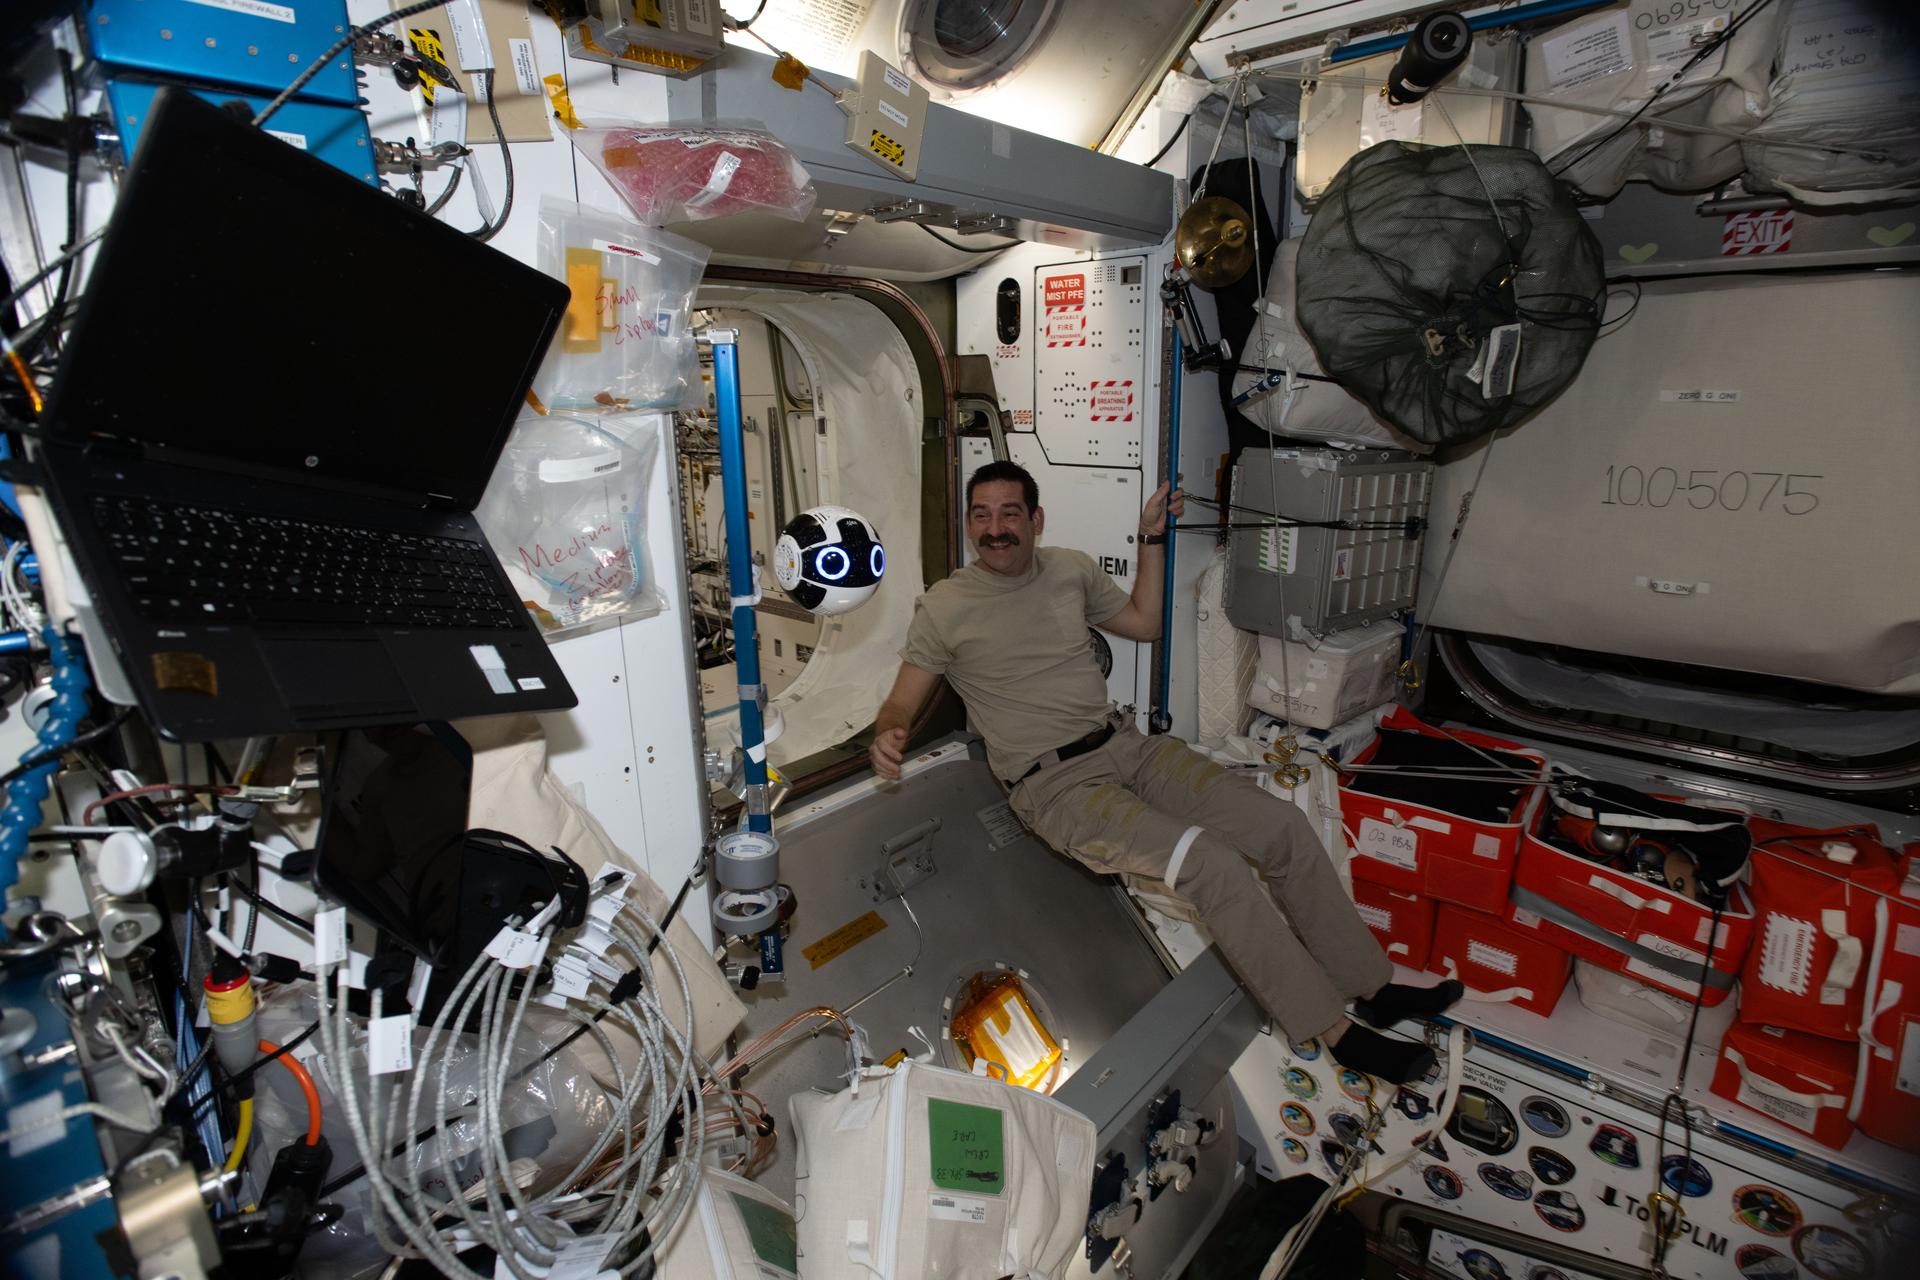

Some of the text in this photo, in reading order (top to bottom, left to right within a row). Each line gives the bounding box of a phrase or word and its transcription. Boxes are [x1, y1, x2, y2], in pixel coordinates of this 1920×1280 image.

[1734, 220, 1783, 244] EXIT
[1049, 278, 1081, 288] WATER
[1046, 290, 1084, 301] MIST PFE
[518, 523, 611, 577] Medium
[1463, 1065, 1486, 1078] DECK
[1479, 1079, 1505, 1094] VALVE
[1625, 1194, 1650, 1221] To
